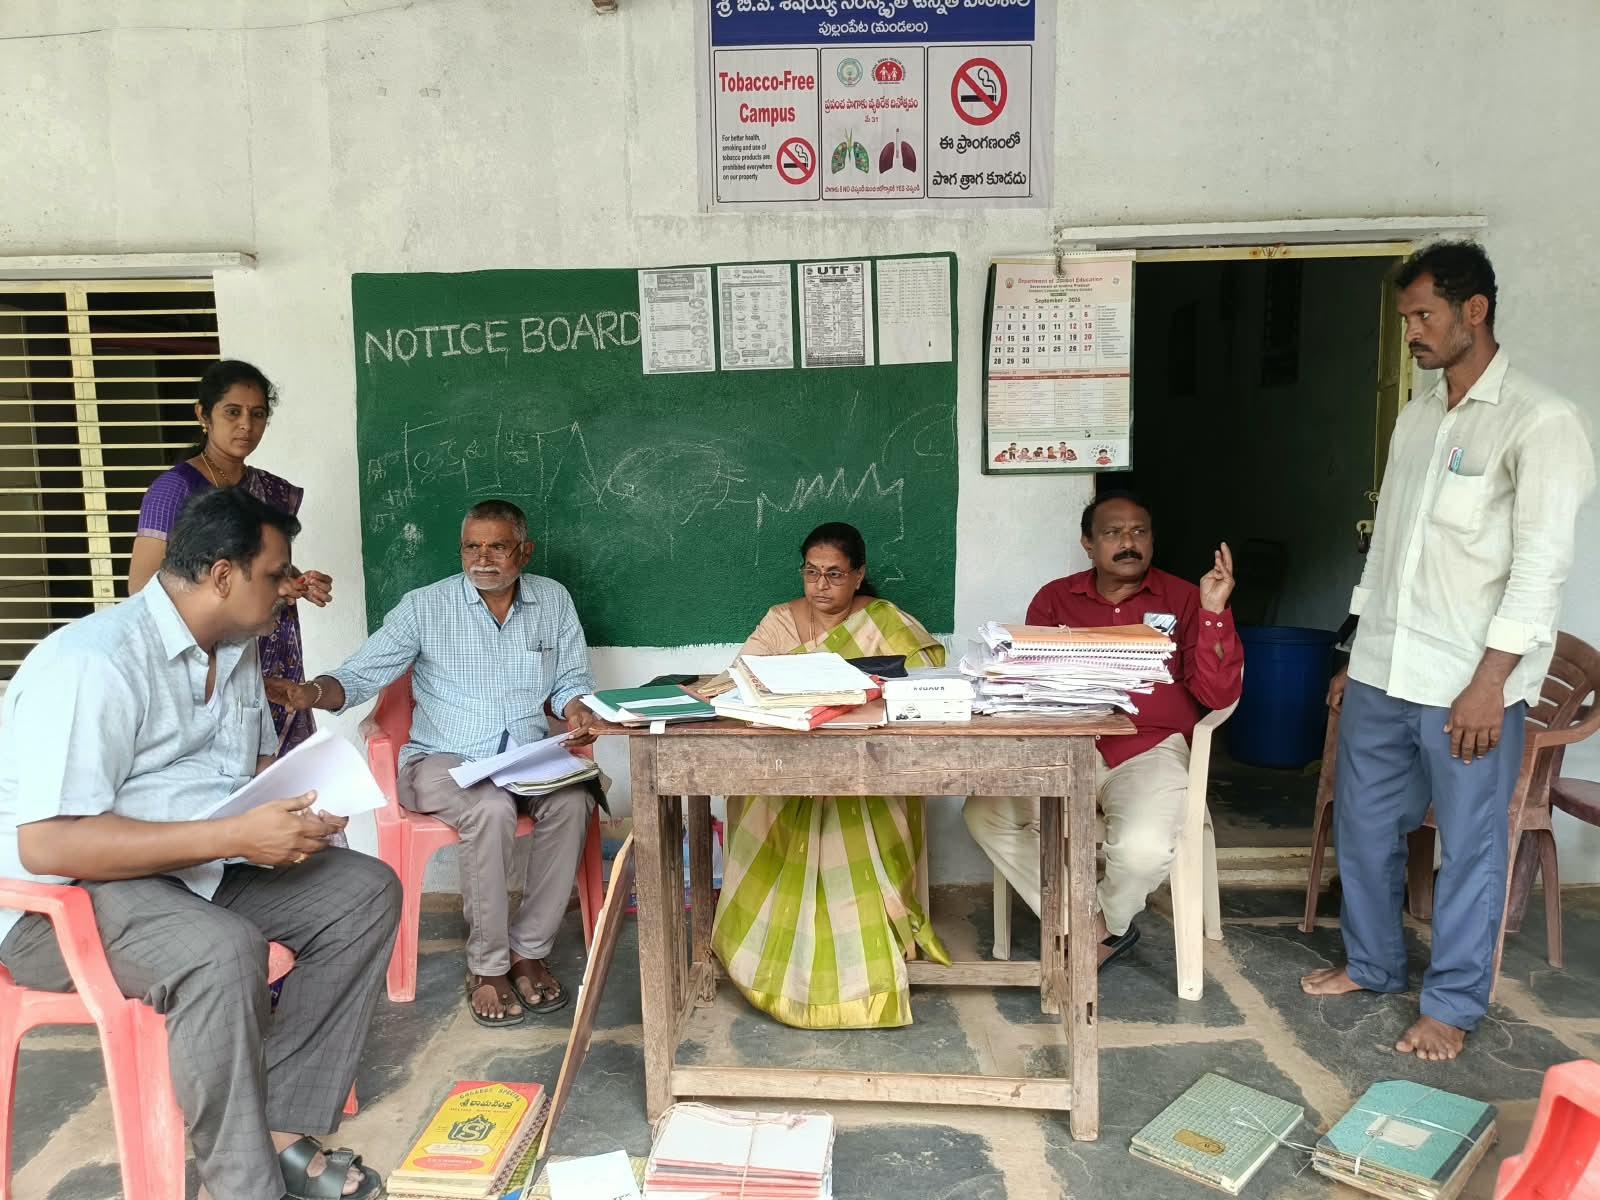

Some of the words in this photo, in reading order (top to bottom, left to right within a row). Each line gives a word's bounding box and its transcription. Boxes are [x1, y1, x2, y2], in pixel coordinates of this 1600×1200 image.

[818, 19, 868, 37] పుల్లంపేట
[871, 20, 929, 34] (మండలం)
[719, 70, 815, 93] Tobacco-Free
[739, 103, 796, 127] Campus
[722, 134, 730, 142] For
[939, 135, 954, 149] ఈ
[956, 131, 1021, 154] ప్రాంగణంలో
[722, 144, 741, 153] smoking
[742, 143, 752, 151] and
[742, 154, 761, 162] products
[722, 163, 746, 171] prohibited
[746, 163, 772, 171] everywhere
[932, 171, 957, 185] పొగ
[959, 172, 983, 190] త్రాగ
[986, 171, 1026, 185] కూడదు
[817, 266, 849, 275] UTF
[364, 319, 509, 364] NOTICE
[521, 311, 641, 353] BOARD
[498, 1088, 521, 1102] SPECIAL
